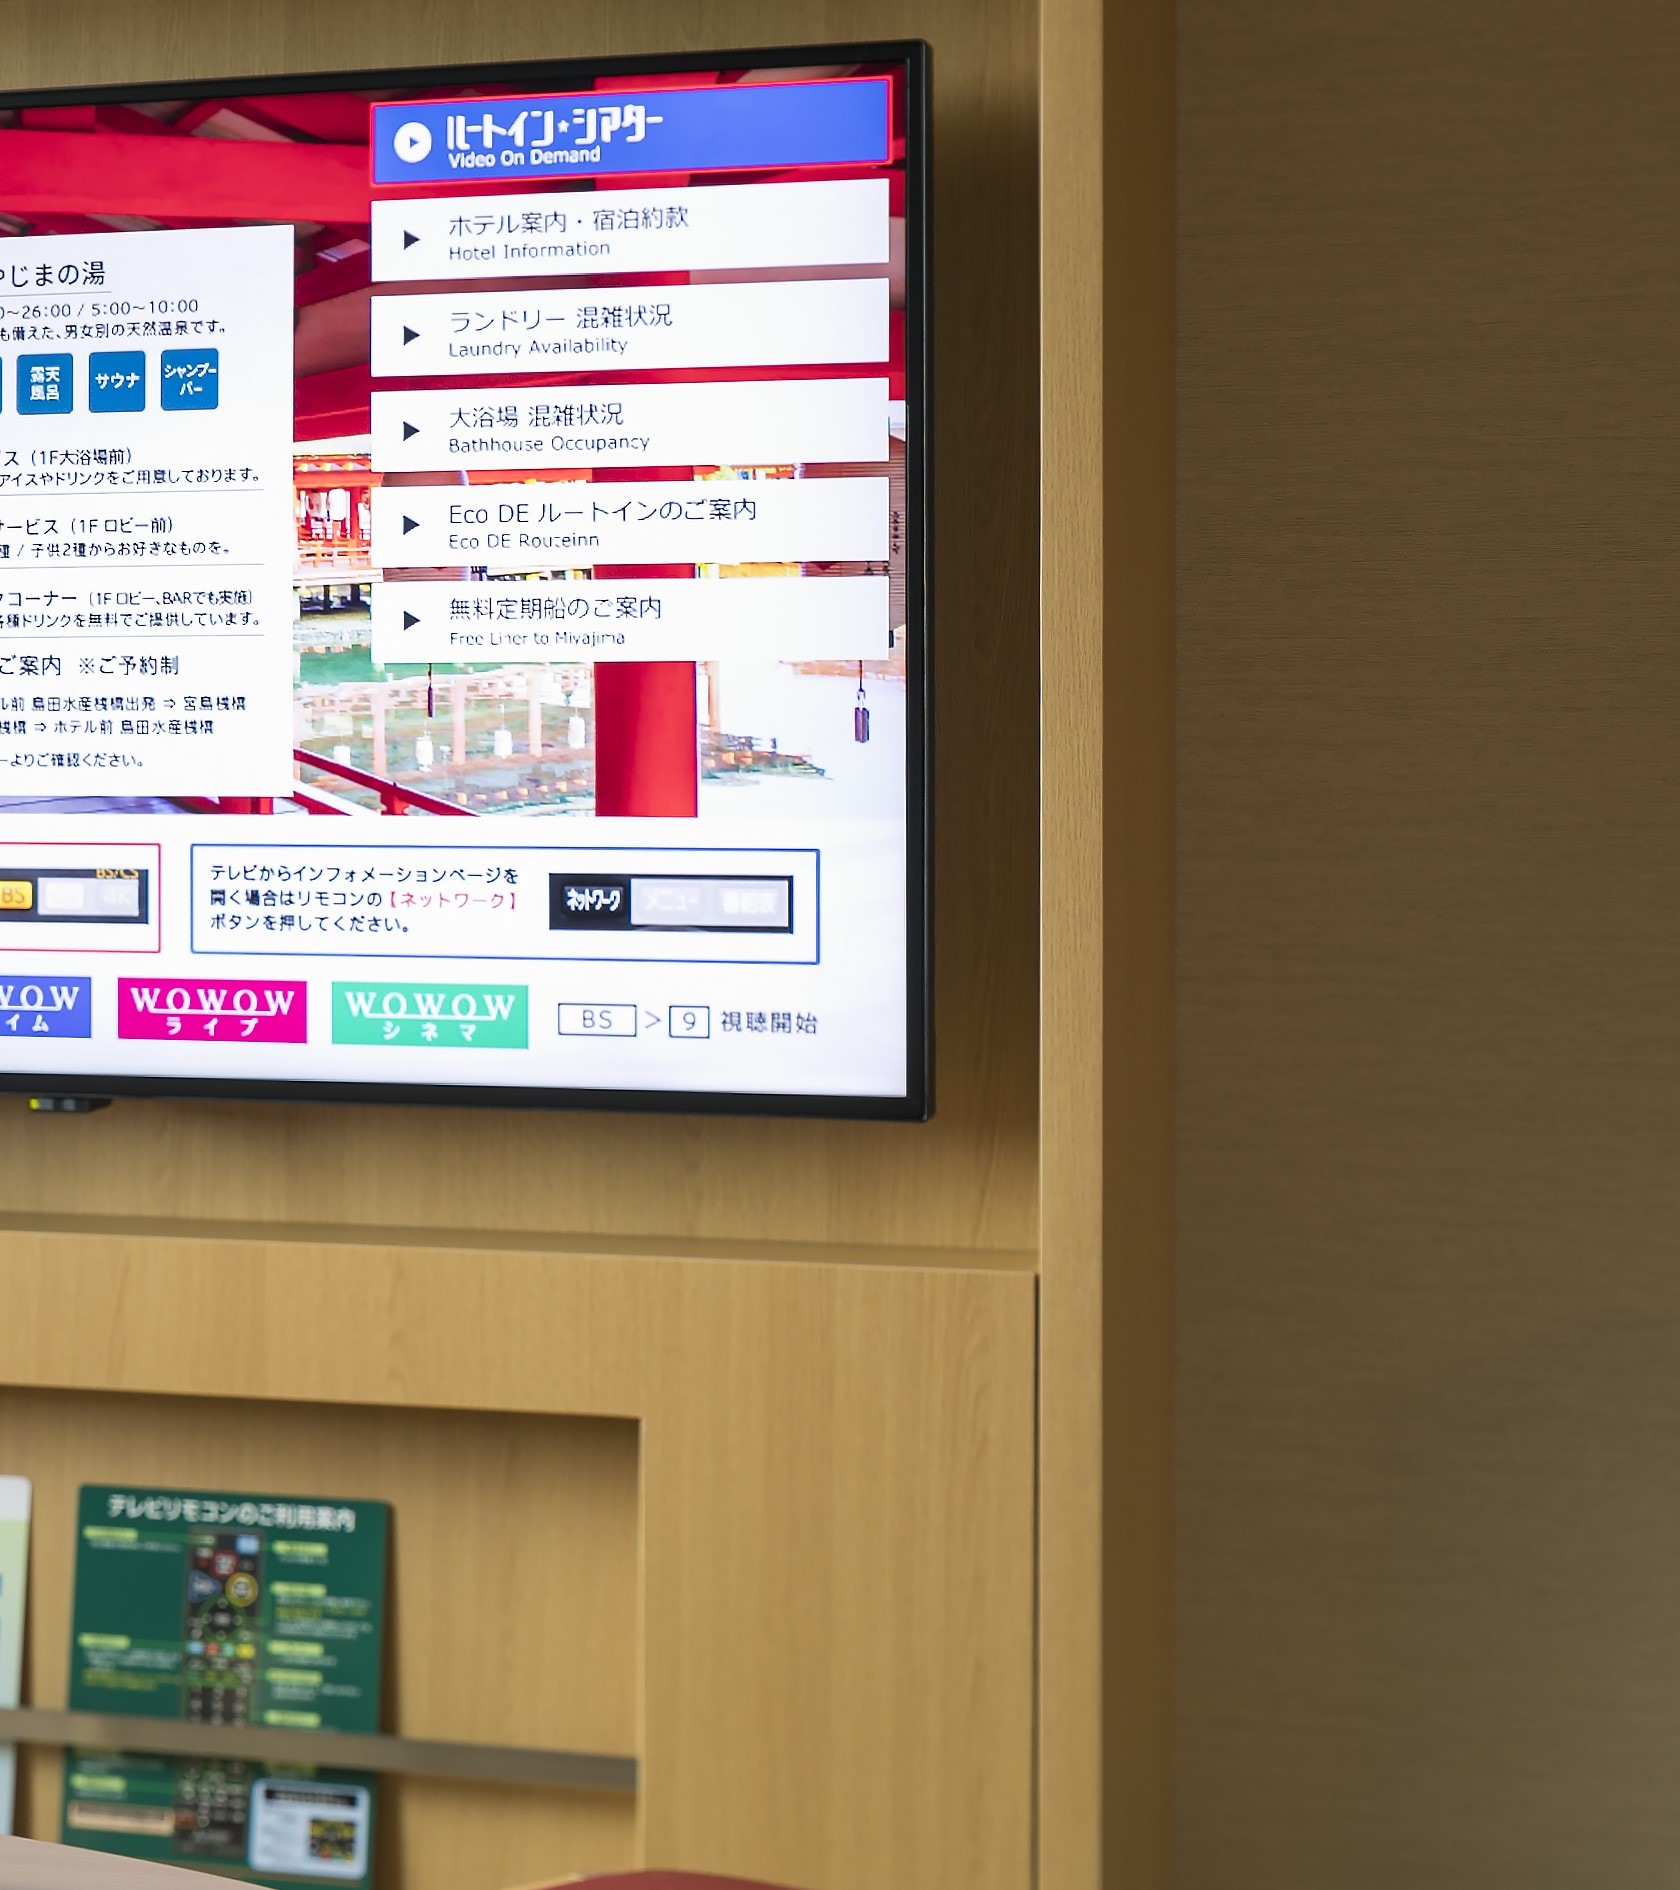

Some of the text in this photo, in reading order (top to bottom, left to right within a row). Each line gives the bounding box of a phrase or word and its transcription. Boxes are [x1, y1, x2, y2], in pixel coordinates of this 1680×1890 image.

[448, 146, 600, 169] Video On Demand
[449, 207, 689, 237] ホテル案内・宿泊約款
[449, 241, 609, 261] Hotel Information
[452, 304, 673, 333] ランドリー 混雑状況
[449, 337, 628, 359] Laundry Availability
[30, 367, 60, 383] 露天
[95, 372, 140, 388] サウナ
[164, 362, 217, 378] シャンプー
[30, 385, 60, 401] 風呂
[450, 403, 622, 429] 大浴場 混雑状況
[449, 434, 649, 455] Bathhouse Occupancy
[450, 499, 756, 524] Eco DE ルートインのご案内
[449, 532, 599, 549] Eco DE Routeinn
[450, 597, 661, 620] 無料定期船のご案内
[450, 633, 483, 645] Free
[534, 633, 548, 644] to
[555, 632, 625, 647] Miyajima
[54, 720, 113, 734] ホテル前
[210, 865, 518, 884] テレビからインフォメーションページを
[1, 887, 25, 904] BS
[567, 888, 621, 912] ネットワーク
[129, 987, 294, 1016] WOWOW
[345, 990, 515, 1021] WOWOW
[166, 1016, 259, 1037] ライブ
[581, 1011, 612, 1029] BS
[682, 1013, 696, 1030] 9
[720, 1011, 818, 1034] 視聴開始
[382, 1021, 477, 1042] シネマ
